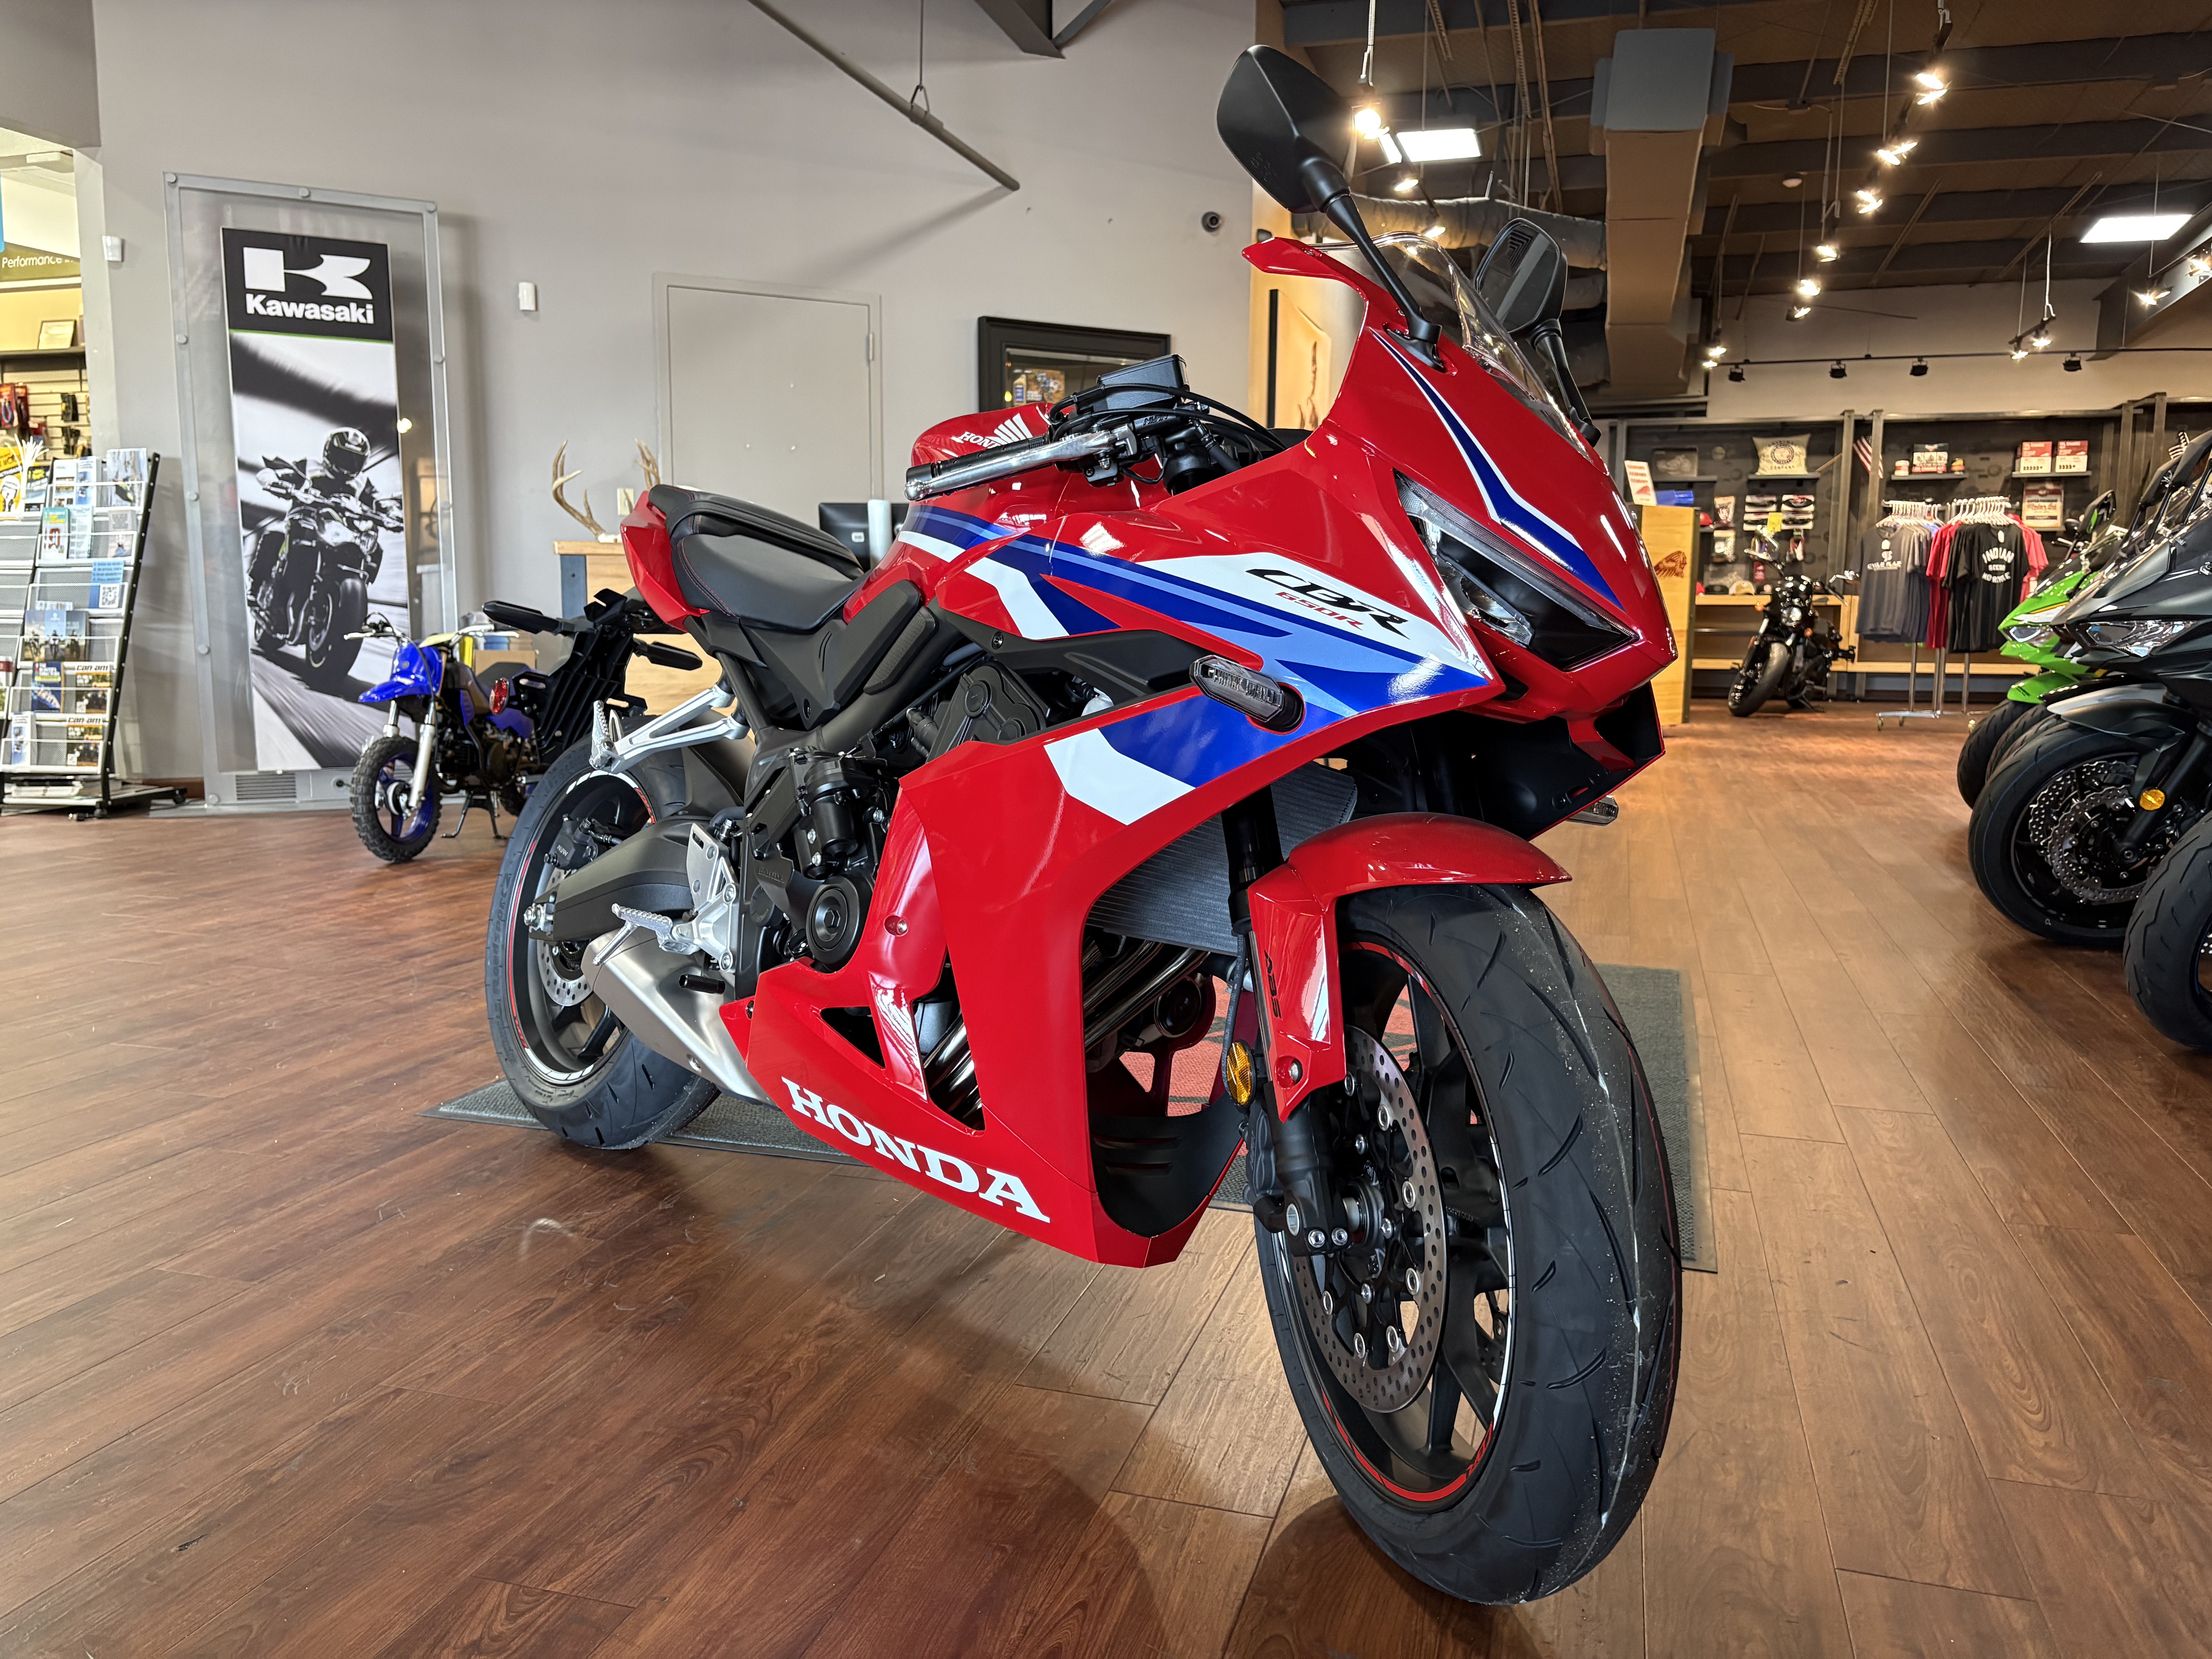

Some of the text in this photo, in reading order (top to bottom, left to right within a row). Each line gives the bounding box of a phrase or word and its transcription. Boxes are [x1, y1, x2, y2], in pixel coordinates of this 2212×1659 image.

[2, 256, 63, 268] Performance
[246, 293, 374, 325] Kawasaki
[1982, 547, 2014, 564] INDIAN
[1245, 568, 1410, 640] CBR
[1275, 591, 1364, 631] 650R
[1264, 949, 1282, 1018] ABS
[781, 1076, 1050, 1224] HONDA
